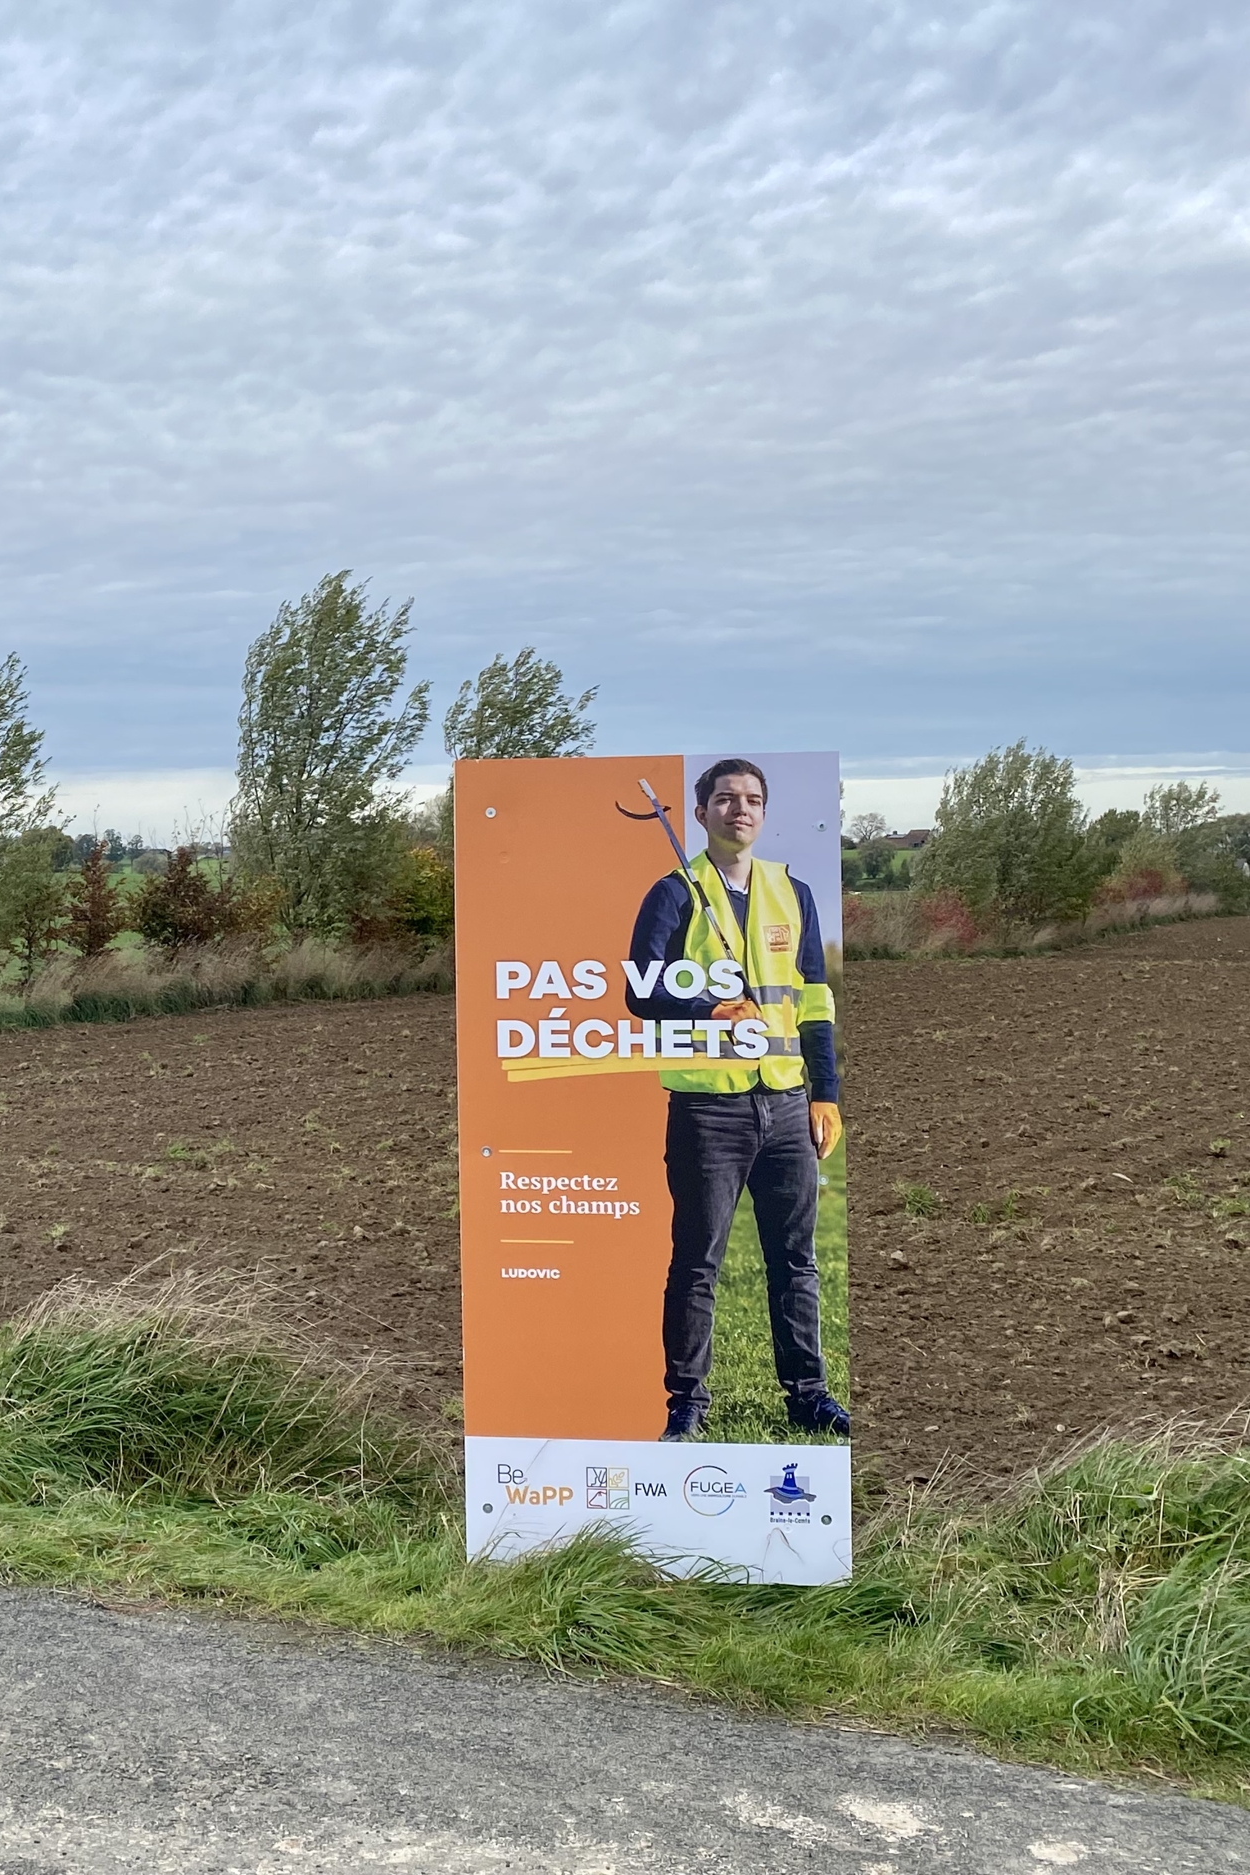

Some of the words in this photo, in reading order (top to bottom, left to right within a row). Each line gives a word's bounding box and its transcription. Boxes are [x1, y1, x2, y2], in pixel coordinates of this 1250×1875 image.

[495, 960, 608, 1000] PAS
[621, 959, 744, 1000] VOS
[497, 1007, 769, 1059] DÉCHETS
[500, 1171, 618, 1195] Respectez
[500, 1199, 542, 1214] nos
[548, 1195, 640, 1219] champs
[501, 1268, 561, 1279] LUDOVIC
[497, 1463, 528, 1484] Be
[505, 1485, 574, 1506] WaPP
[634, 1483, 668, 1497] FWA
[690, 1481, 747, 1494] FUGEA
